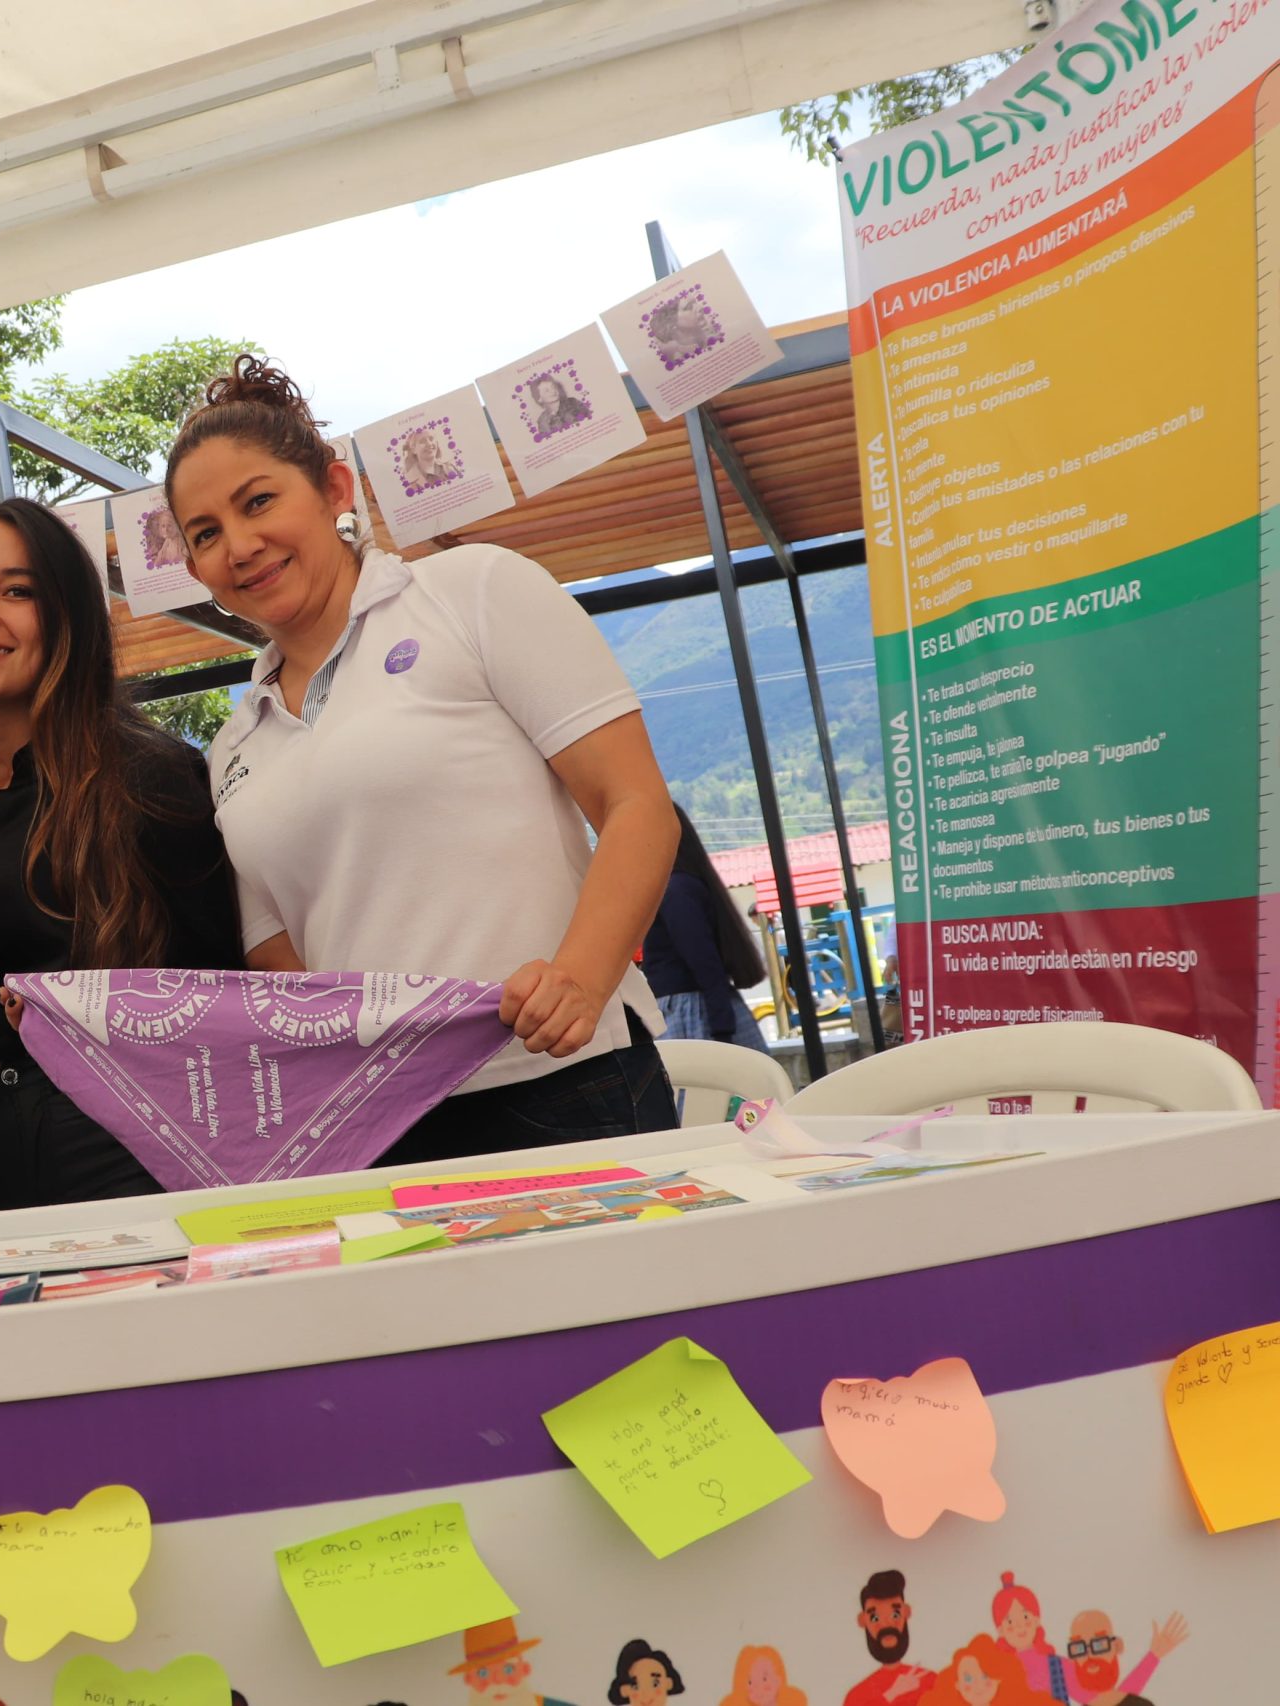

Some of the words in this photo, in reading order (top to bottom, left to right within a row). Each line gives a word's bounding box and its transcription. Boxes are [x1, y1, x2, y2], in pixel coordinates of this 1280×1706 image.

[843, 0, 1202, 216] VIOLENTÓME
[989, 144, 1057, 192] nada
[1060, 76, 1161, 166] justifica
[1163, 53, 1193, 84] la
[965, 185, 1051, 240] contra
[1053, 166, 1090, 202] las
[881, 295, 904, 318] LA
[909, 254, 1011, 307] VIOLENCIA
[1014, 188, 1128, 267] AUMENTARÁ
[901, 330, 938, 351] hace
[941, 311, 996, 339] bromas
[999, 282, 1060, 318] hirientes
[1063, 274, 1073, 289] o
[1074, 247, 1128, 287] piropos
[1130, 204, 1196, 253] ofensivos
[902, 341, 968, 372] amenaza
[904, 364, 960, 392] intimida
[905, 386, 952, 413] humilla
[956, 384, 966, 397] o
[969, 359, 1036, 392] ridiculiza
[953, 402, 977, 418] tus
[981, 376, 1051, 411] opiniones
[942, 493, 962, 508] tus
[967, 470, 1045, 501] amistades
[1048, 466, 1058, 478] o
[1061, 457, 1082, 475] las
[1084, 427, 1158, 466] relaciones
[1161, 417, 1188, 436] con
[1189, 405, 1205, 424] tu
[944, 460, 1000, 486] objetos
[867, 432, 894, 547] ALERTA
[978, 527, 1002, 543] tus
[1006, 502, 1087, 536] decisiones
[986, 542, 1030, 562] vestir
[1034, 541, 1043, 552] o
[1046, 511, 1128, 550] maquillarte
[920, 596, 932, 611] Te
[920, 638, 938, 660] ES
[939, 632, 956, 653] EL
[955, 608, 1025, 647] MOMENTO
[1029, 601, 1059, 627] DE
[1063, 579, 1142, 620] ACTUAR
[928, 688, 940, 703] Te
[941, 683, 964, 700] trata
[980, 661, 1035, 687] desprecio
[929, 710, 941, 724] Te
[943, 701, 976, 722] ofende
[930, 732, 943, 746] Te
[945, 723, 978, 743] insulta
[931, 754, 945, 768] Te
[946, 744, 986, 765] empuja,
[933, 775, 946, 790] Te
[948, 768, 989, 791] pellizca,
[990, 764, 1001, 779] te
[1035, 749, 1089, 773] golpea
[889, 710, 919, 893] REACCIONA
[934, 797, 948, 812] Te
[949, 789, 989, 810] acaricia
[936, 819, 949, 833] Te
[951, 813, 995, 831] manosea
[937, 838, 973, 856] Maneja
[974, 839, 981, 854] y
[983, 831, 1024, 851] dispone
[1046, 823, 1089, 840] dinero,
[1093, 819, 1120, 835] tus
[1125, 813, 1173, 833] bienes
[1176, 811, 1186, 825] o
[1188, 806, 1210, 823] tus
[933, 859, 994, 878] documentos
[939, 884, 952, 899] Te
[994, 880, 1018, 894] usar
[1062, 865, 1175, 887] anticonceptivos
[942, 923, 989, 945] BUSCA
[991, 920, 1043, 942] AYUDA:
[943, 954, 960, 972] Tu
[961, 952, 989, 971] vida
[991, 957, 1000, 971] e
[1002, 950, 1070, 975] integridad
[1070, 948, 1111, 970] están
[1112, 951, 1132, 969] en
[1136, 946, 1198, 973] riesgo
[110, 994, 210, 1038] VALIENTE
[270, 1009, 352, 1040] MUJER
[943, 1005, 956, 1020] Te
[957, 1005, 992, 1023] golpea
[994, 1009, 1001, 1020] o
[1003, 1005, 1041, 1024] agrede
[186, 1057, 197, 1070] de
[248, 1043, 259, 1069] Libre
[202, 1067, 213, 1088] una
[250, 1067, 264, 1094] Vida
[265, 1058, 283, 1115] Violencias!
[187, 1070, 204, 1124] Violencias!
[204, 1087, 217, 1114] Vida
[254, 1094, 266, 1115] una
[207, 1114, 220, 1139] Libre
[270, 1114, 283, 1125] de
